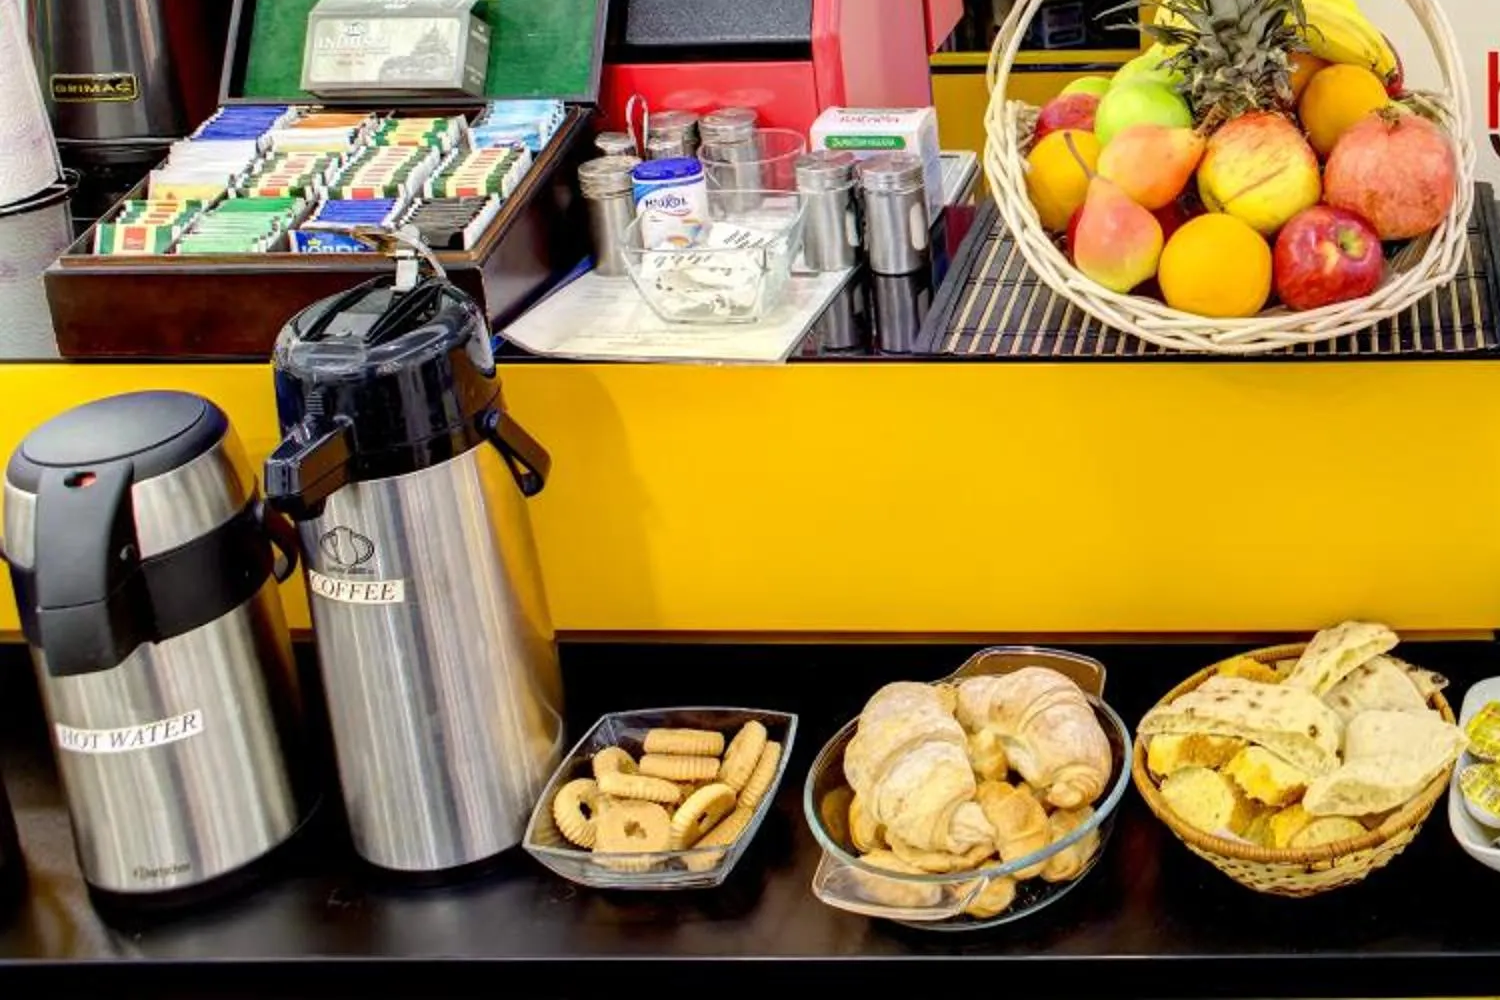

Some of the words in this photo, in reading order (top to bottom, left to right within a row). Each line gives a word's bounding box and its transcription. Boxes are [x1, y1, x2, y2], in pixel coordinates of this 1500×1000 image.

[311, 573, 396, 602] COFFEE
[61, 727, 102, 750] HOT
[109, 714, 198, 748] WATER
